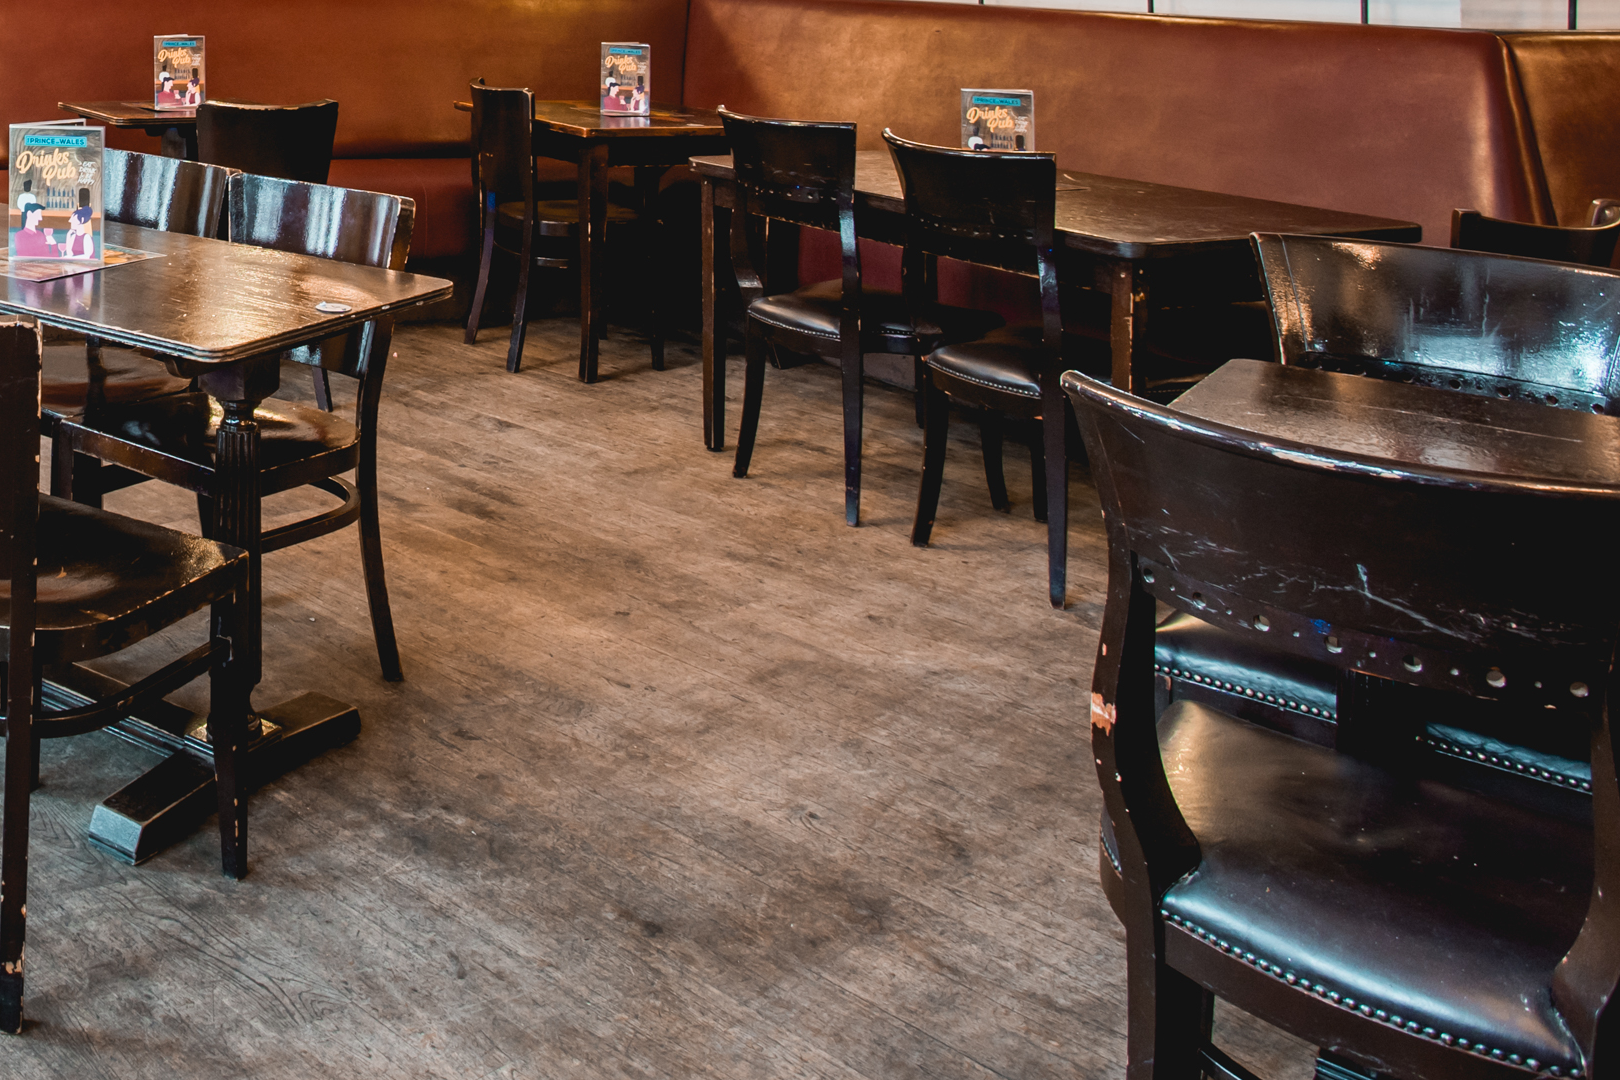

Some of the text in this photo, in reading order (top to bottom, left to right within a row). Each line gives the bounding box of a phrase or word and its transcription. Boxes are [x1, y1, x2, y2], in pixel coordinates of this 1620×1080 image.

[157, 47, 187, 62] Drinks
[172, 56, 191, 68] Pub
[605, 55, 633, 68] Drinks
[618, 62, 637, 74] Pub
[966, 106, 1008, 124] Drinks
[987, 116, 1015, 133] Pub
[30, 137, 55, 145] PRINCE
[15, 148, 70, 174] Drinks
[42, 162, 77, 187] Pub
